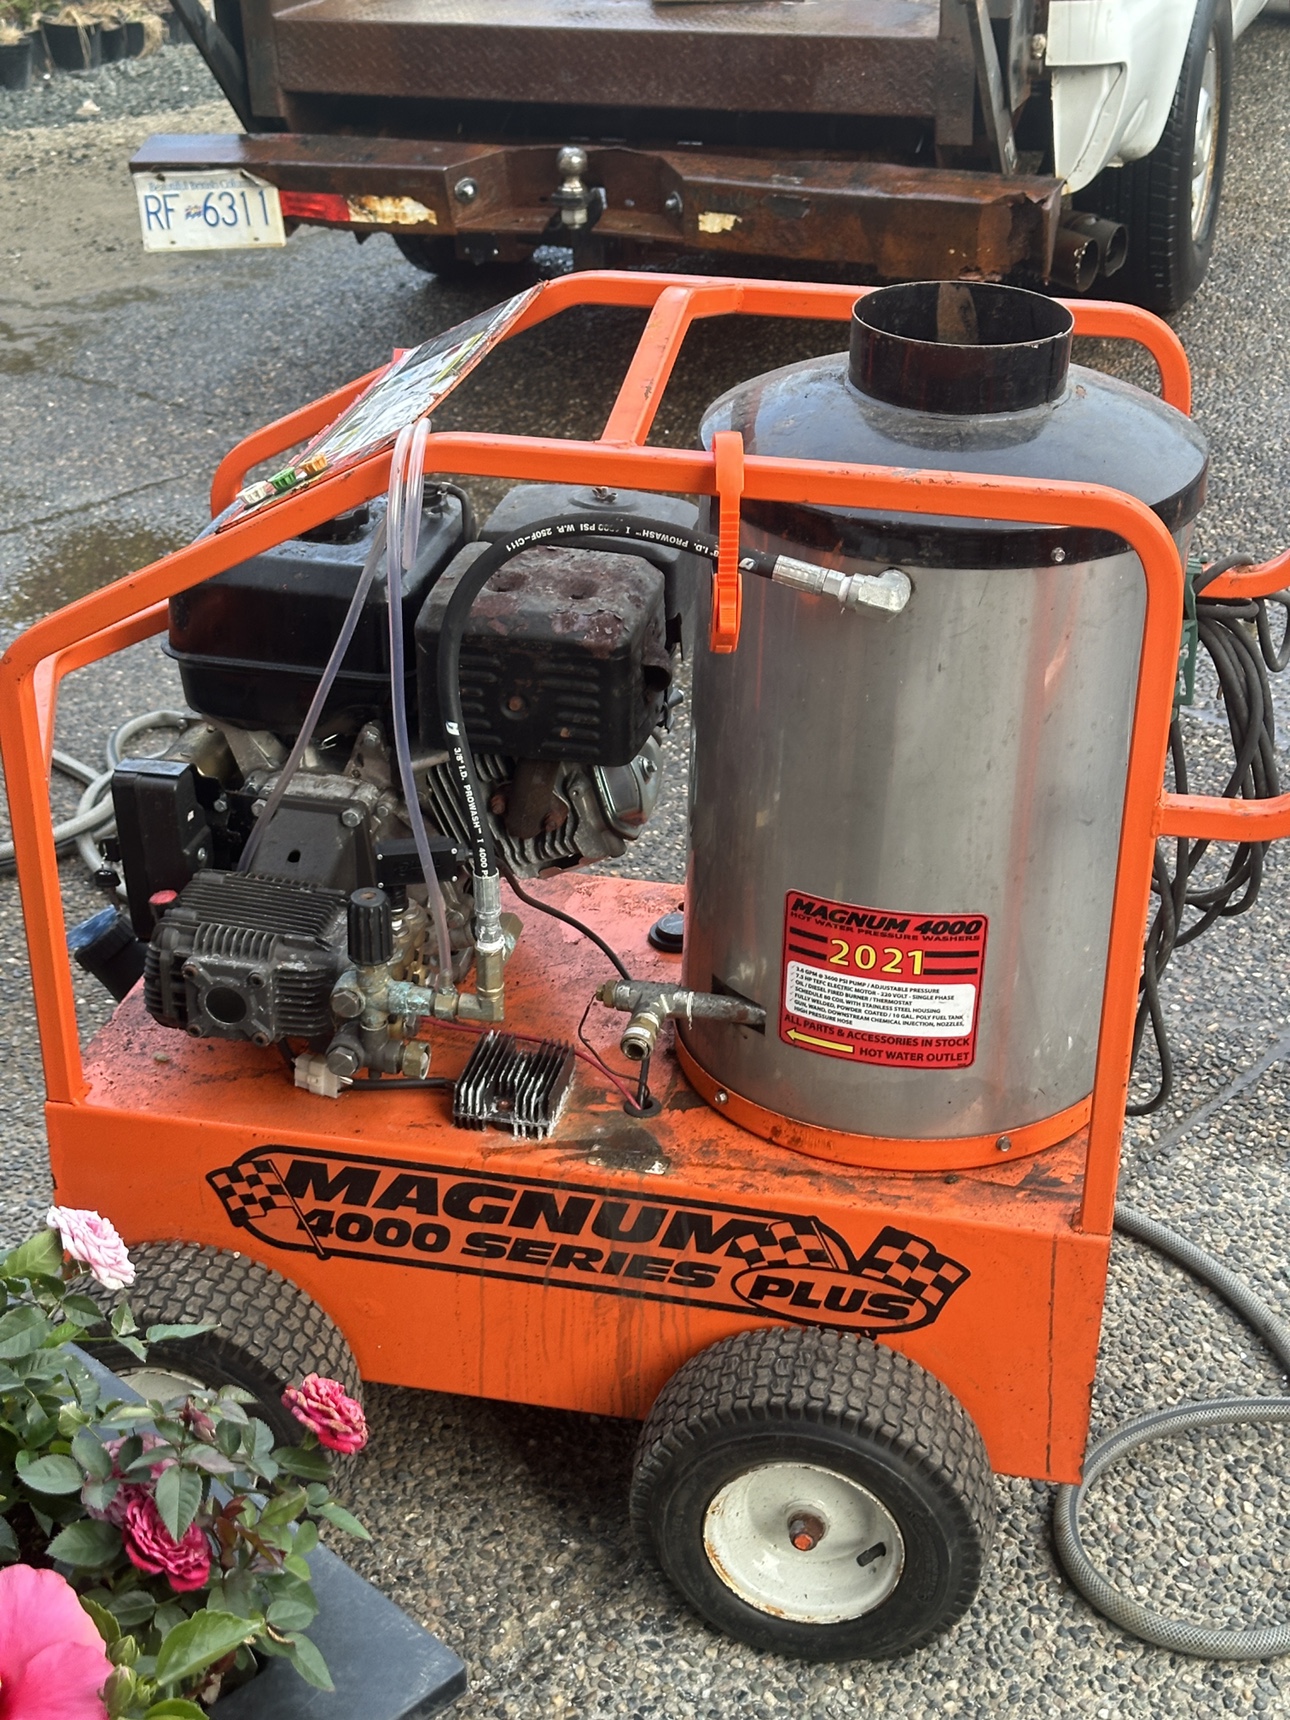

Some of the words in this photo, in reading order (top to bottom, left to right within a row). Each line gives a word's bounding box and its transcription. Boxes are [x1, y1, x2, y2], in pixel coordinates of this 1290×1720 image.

[144, 194, 179, 230] RF
[202, 190, 269, 227] 6311
[556, 523, 575, 534] W.P.
[580, 523, 596, 532] PSI
[478, 847, 488, 869] 4000
[790, 911, 812, 922] HOT
[815, 919, 854, 933] WATER
[857, 926, 919, 941] PRESSURE
[922, 934, 980, 942] WASHERS
[791, 898, 911, 933] MAGNUM
[913, 920, 983, 936] 4000
[829, 938, 924, 976] 2021
[805, 969, 818, 977] GPM
[849, 979, 866, 988] PUMP
[871, 984, 909, 993] ADJUSTABLE
[827, 982, 854, 992] ELECTRIC
[854, 987, 876, 995] MOTOR
[794, 992, 810, 1001] FULLY
[836, 1003, 862, 1013] POWDER
[864, 1009, 888, 1017] COATED
[795, 986, 823, 999] SCHEDULE
[831, 996, 845, 1004] COIL
[862, 1002, 893, 1011] STAINLESS
[808, 983, 826, 993] DIESEL
[827, 988, 844, 997] FIRED
[845, 992, 869, 1001] BURNER
[873, 997, 912, 1006] THERMOSTAT
[794, 1006, 808, 1015] HIGH
[808, 1010, 836, 1022] PRESSURE
[827, 1009, 870, 1021] DOWNSTREAM
[871, 1017, 902, 1026] CHEMICAL
[784, 1014, 802, 1027] ALL
[803, 1019, 835, 1035] PARTS
[837, 1029, 845, 1037] &
[847, 1031, 919, 1047] ACCESSORIES
[921, 1039, 932, 1047] IN
[934, 1038, 970, 1047] STOCK
[859, 1047, 883, 1058] HOT
[885, 1050, 924, 1061] WATER
[926, 1052, 970, 1062] OUTLET
[283, 1159, 766, 1258] MAGNUM
[297, 1208, 451, 1253] 4000
[460, 1232, 722, 1289] SERIES
[748, 1274, 917, 1320] PLUS
